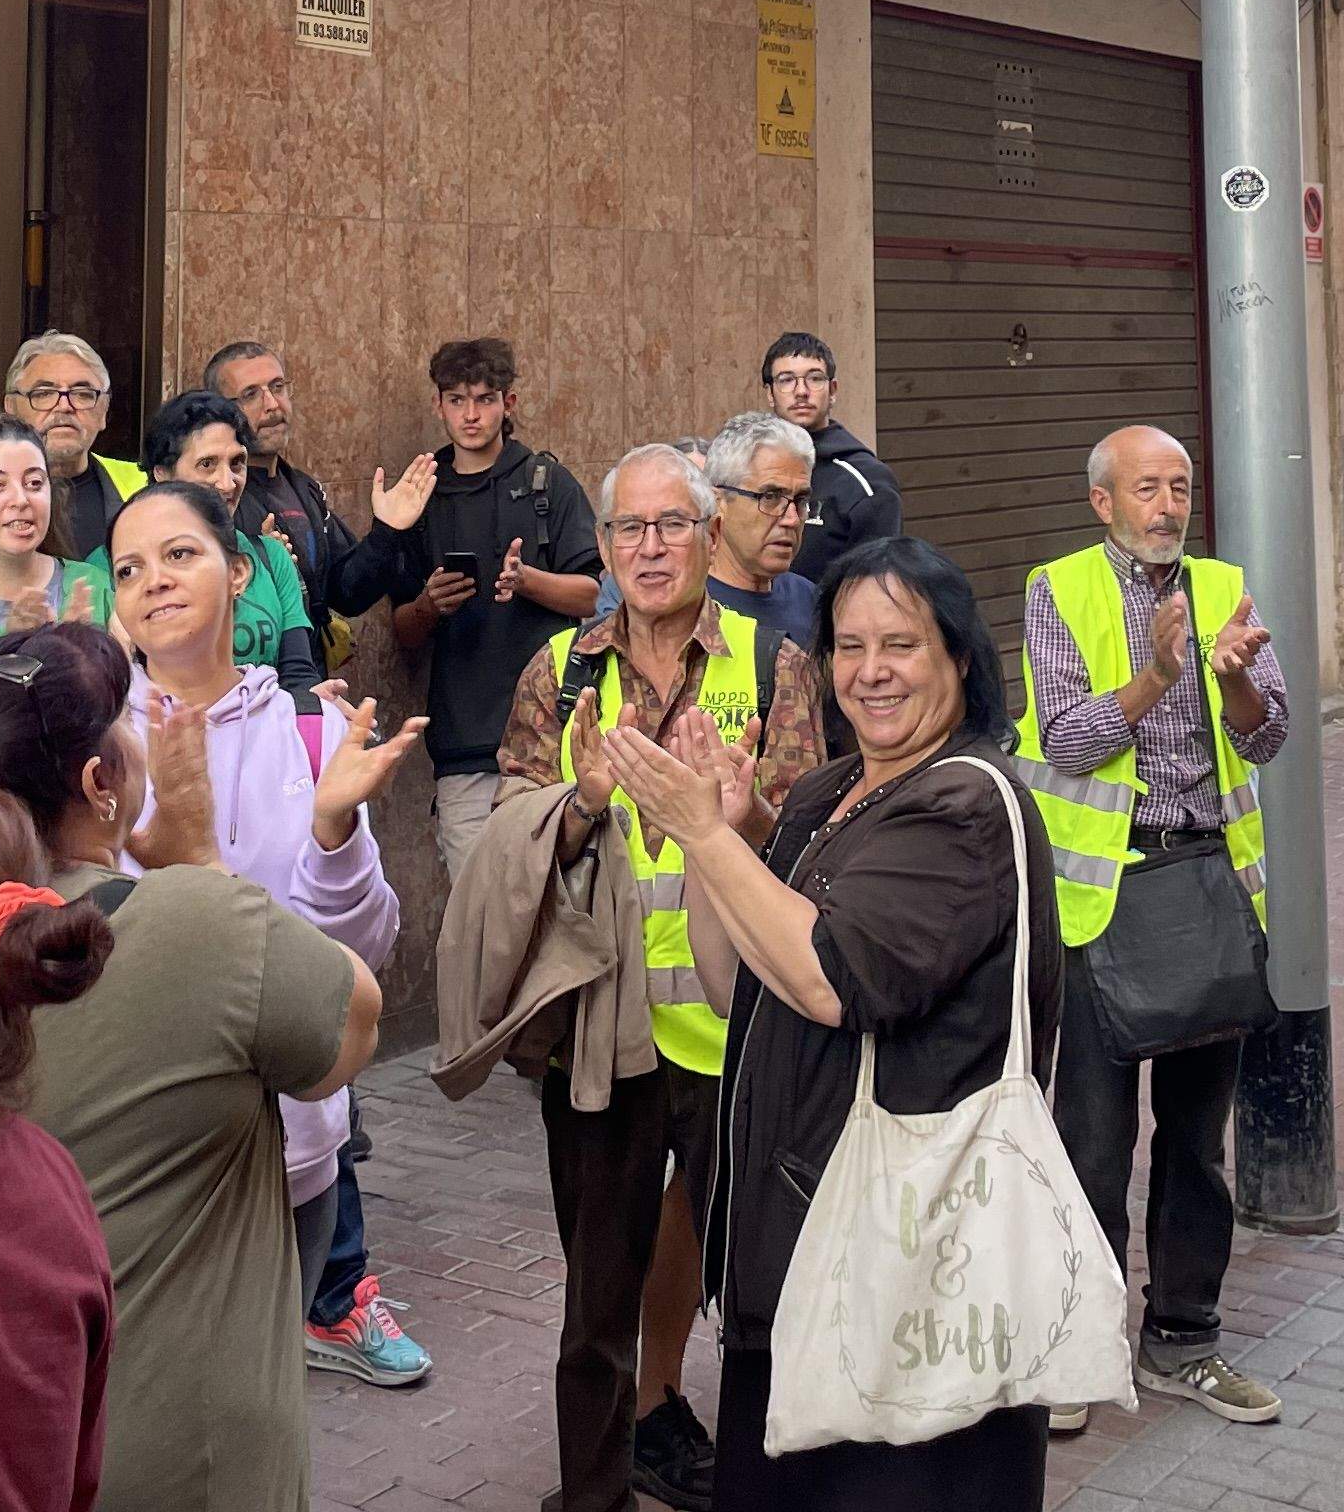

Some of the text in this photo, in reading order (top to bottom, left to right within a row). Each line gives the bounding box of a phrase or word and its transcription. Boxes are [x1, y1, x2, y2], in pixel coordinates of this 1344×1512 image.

[233, 619, 273, 658] OP
[899, 1155, 994, 1260] food
[930, 1225, 973, 1299] &
